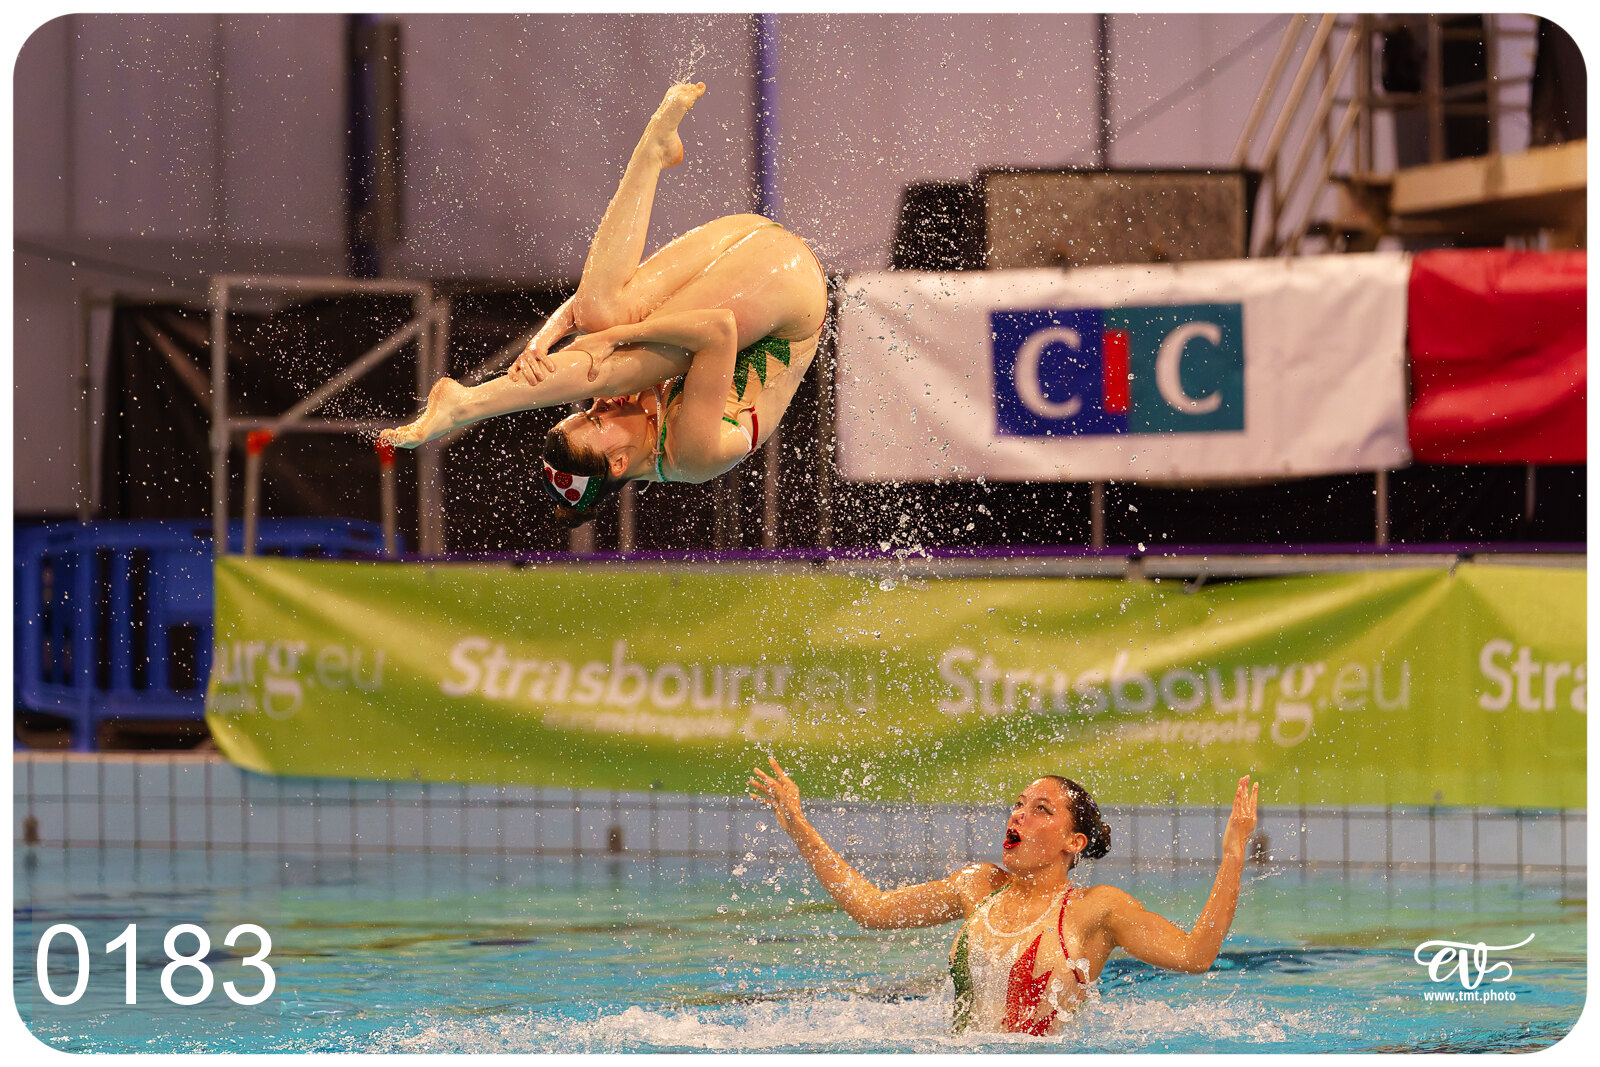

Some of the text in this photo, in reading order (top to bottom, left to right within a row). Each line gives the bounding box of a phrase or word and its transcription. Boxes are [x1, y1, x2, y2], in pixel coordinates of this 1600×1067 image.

[1014, 321, 1223, 419] CIC
[211, 638, 386, 720] urg.eu
[441, 635, 878, 742] Strasbourg.eu
[935, 646, 1411, 746] Strasbourg.eu
[1478, 638, 1588, 713] Stra
